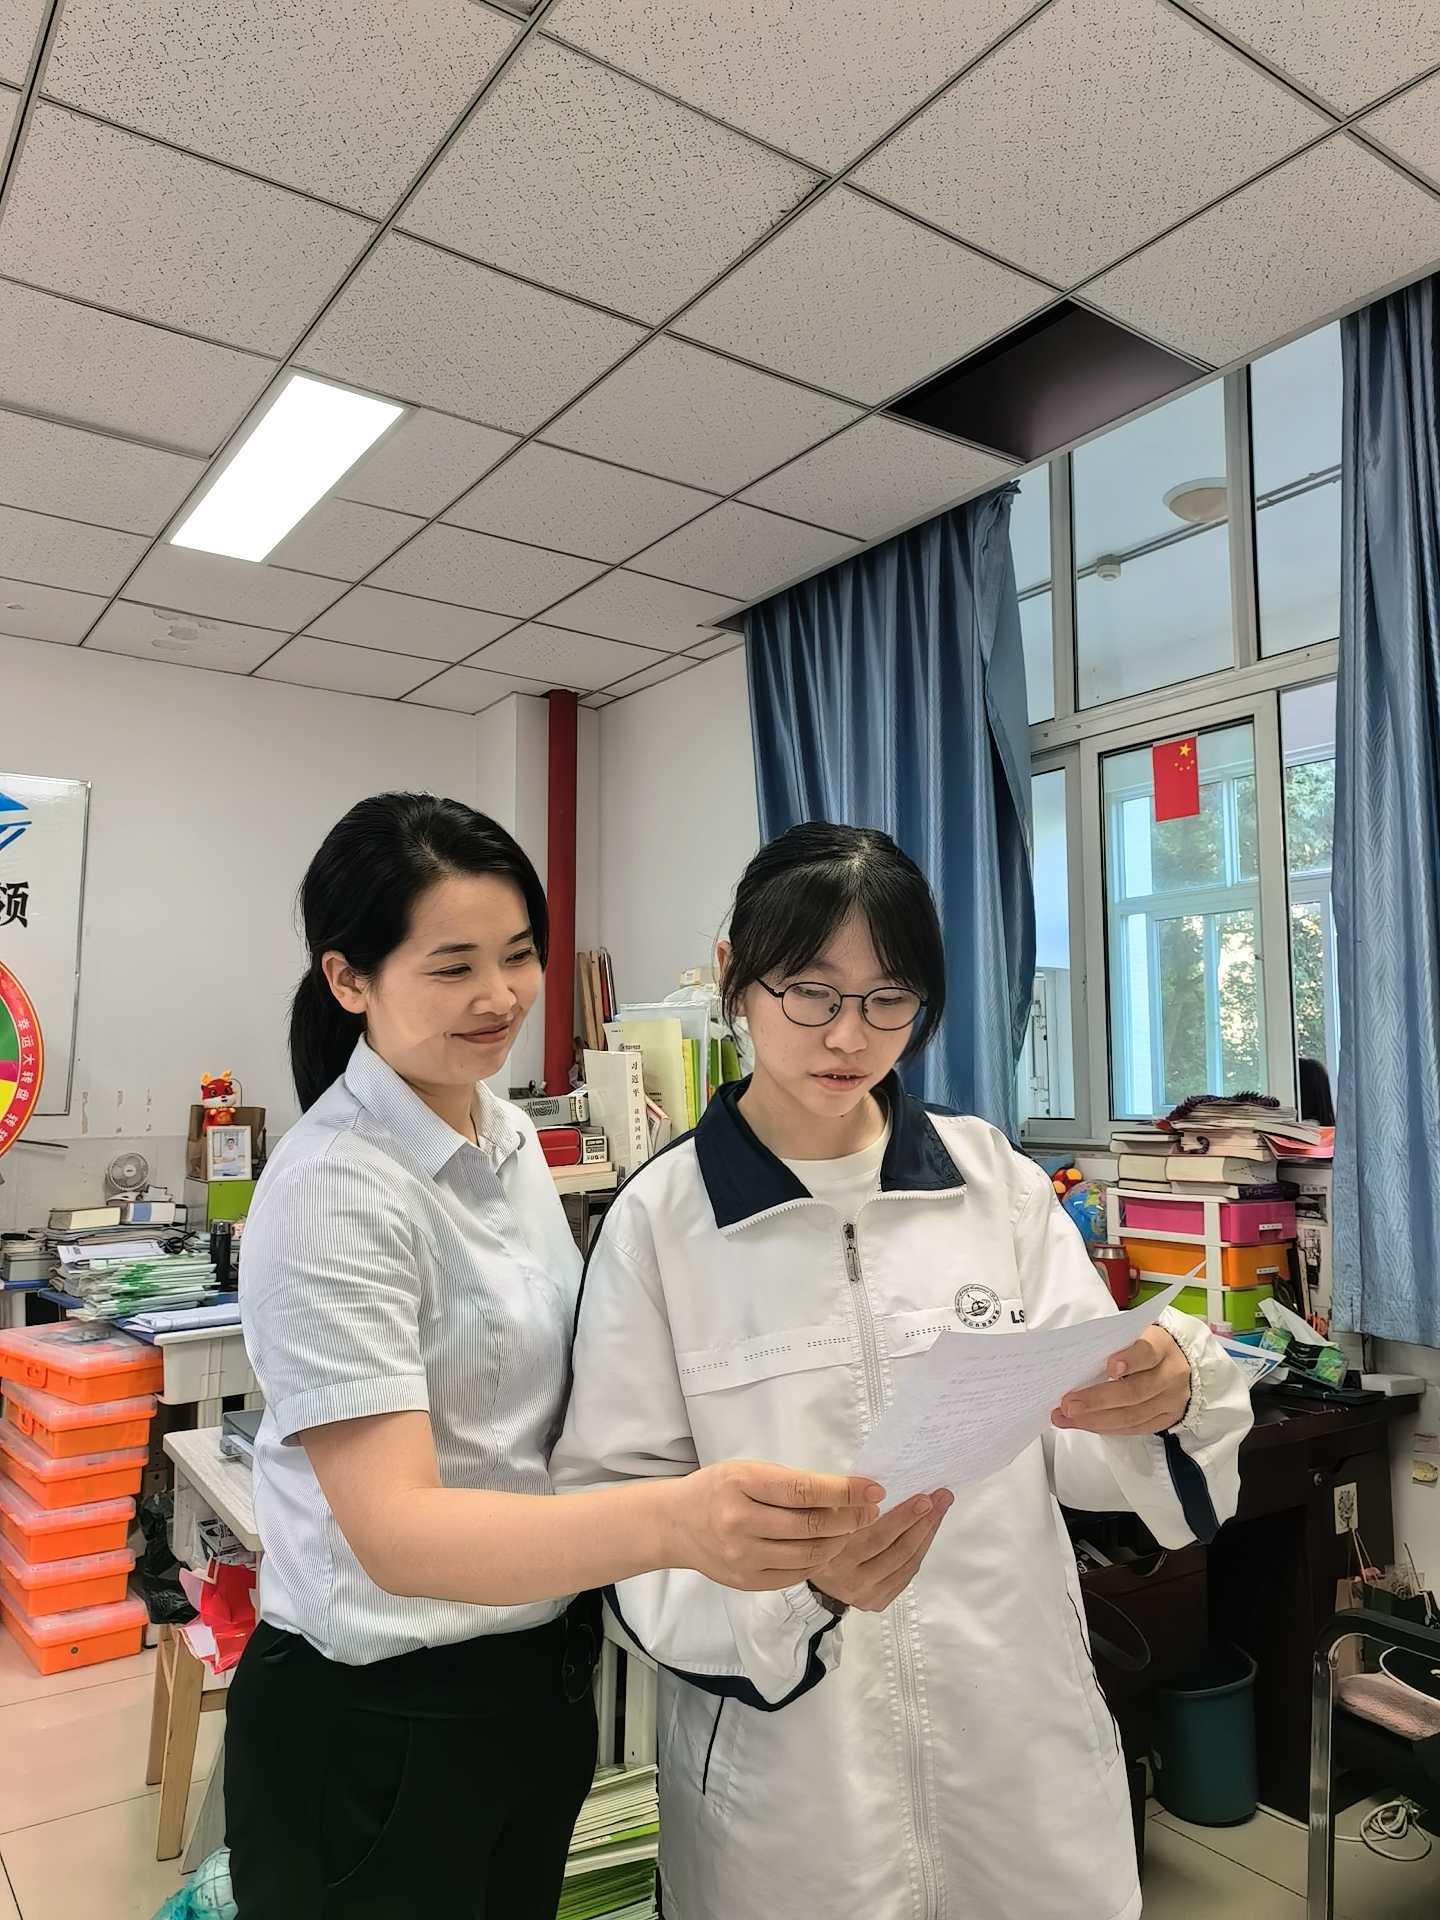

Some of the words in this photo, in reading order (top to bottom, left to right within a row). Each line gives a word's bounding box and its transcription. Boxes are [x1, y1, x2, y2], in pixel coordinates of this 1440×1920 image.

[16, 1018, 35, 1101] 幸运大转盘
